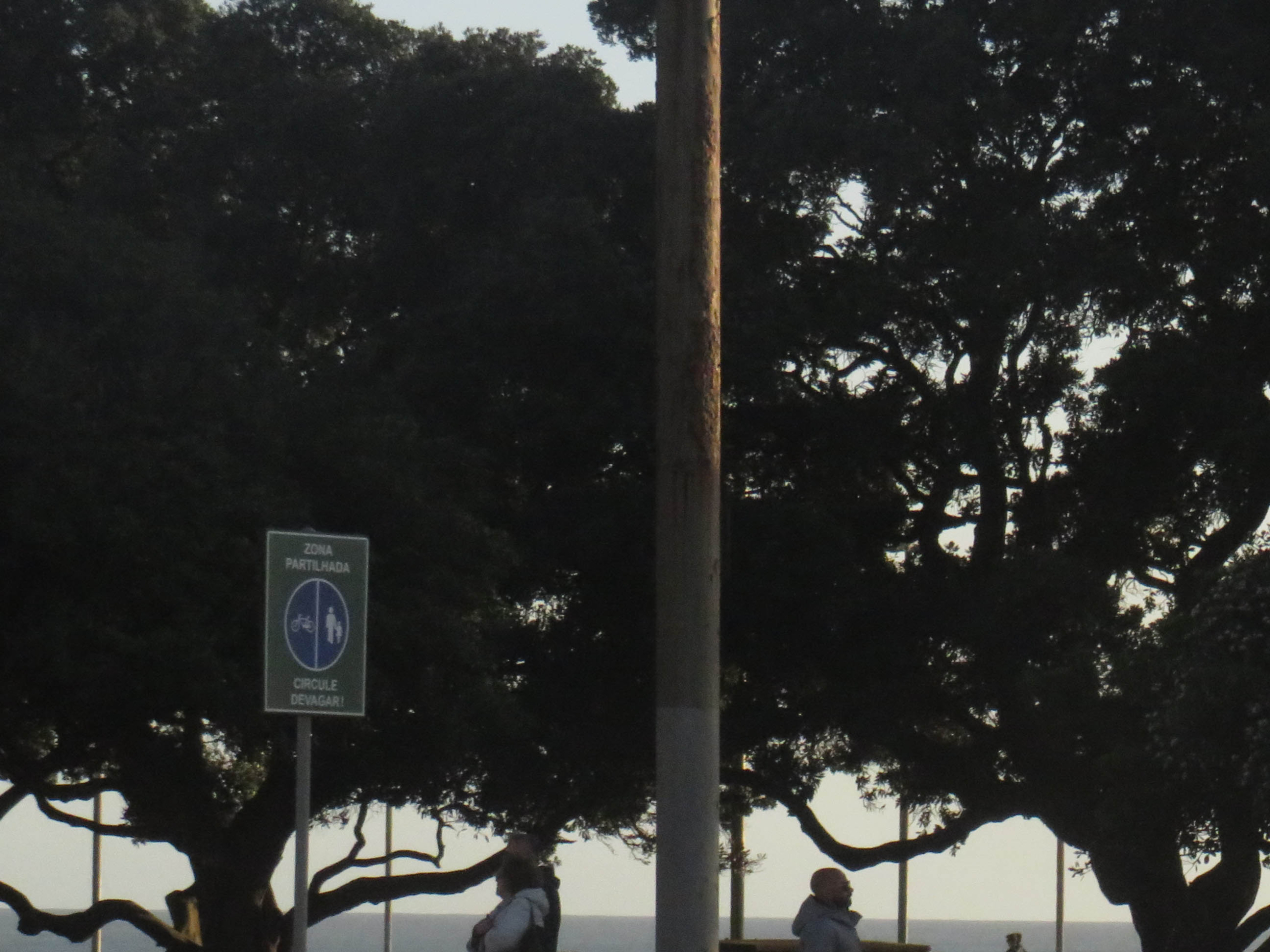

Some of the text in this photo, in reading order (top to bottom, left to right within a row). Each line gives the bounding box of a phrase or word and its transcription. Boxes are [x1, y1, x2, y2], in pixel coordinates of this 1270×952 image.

[304, 543, 333, 556] ZONA
[286, 558, 350, 573] PARTILHADA
[293, 677, 338, 691] CIRCULE
